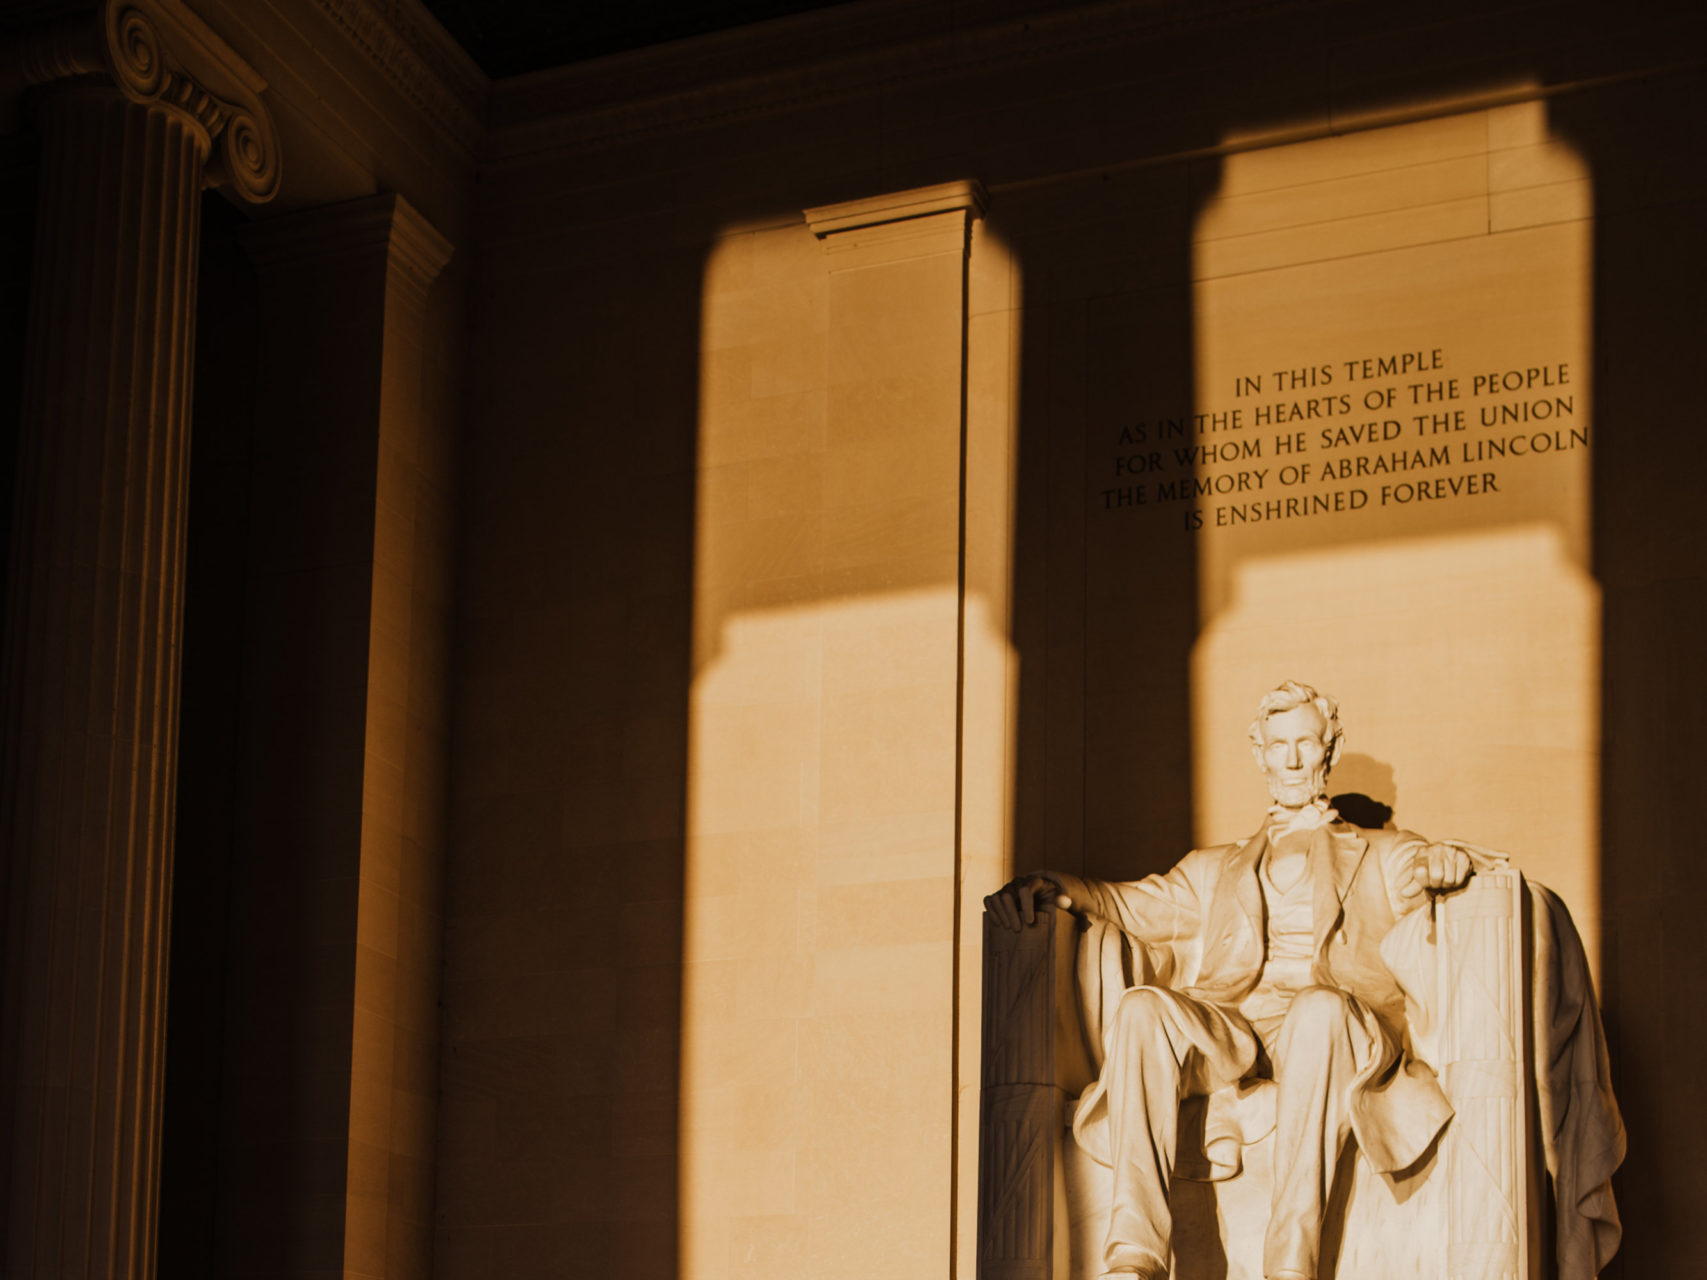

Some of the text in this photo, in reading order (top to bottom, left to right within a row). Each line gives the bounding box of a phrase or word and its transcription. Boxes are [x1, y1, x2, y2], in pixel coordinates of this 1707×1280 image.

[1119, 364, 1570, 445] AS IN THE HEARTS OF THE PEOPLE
[1235, 349, 1444, 397] IN THIS TEMPLE
[1101, 427, 1590, 509] THE MEMORY OF ABRAHAM LINCOLN
[1115, 396, 1574, 476] FOR WHOM HE SAVED THE UNION
[1184, 473, 1500, 530] IS ENSHRINED FOREVER
